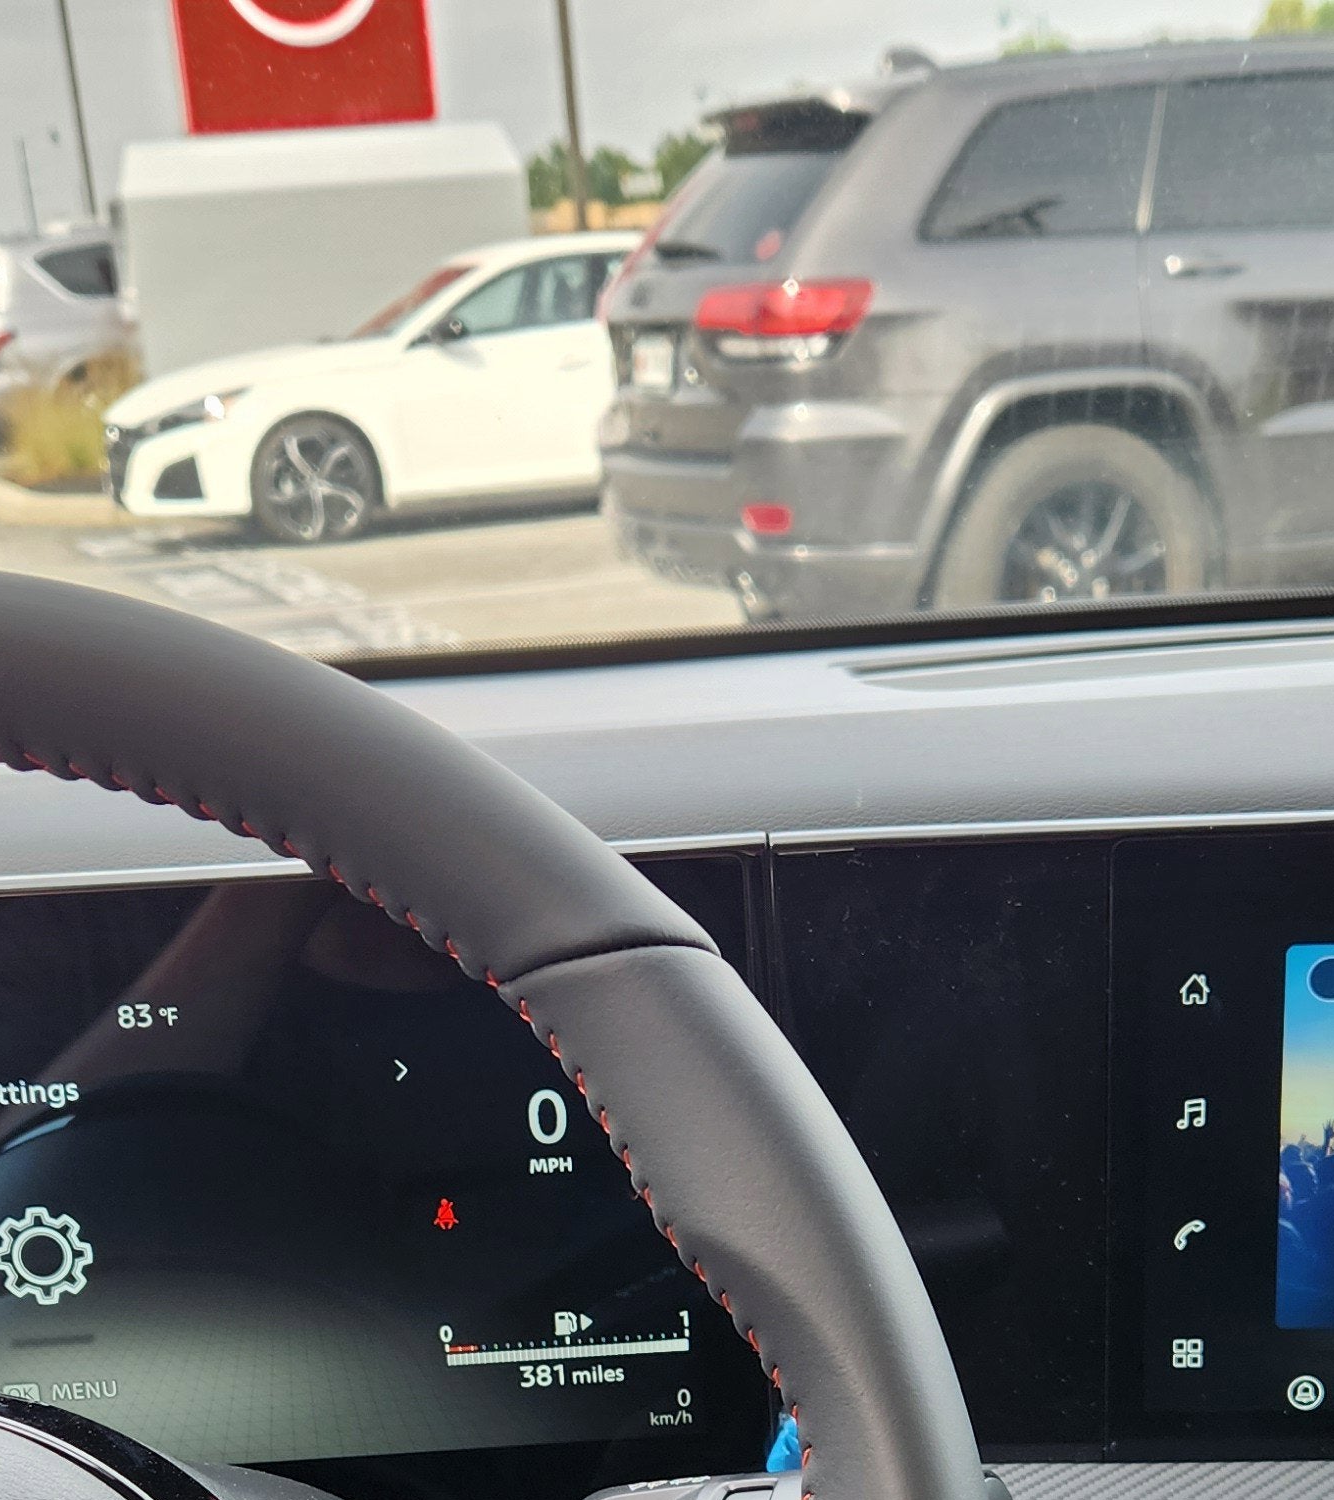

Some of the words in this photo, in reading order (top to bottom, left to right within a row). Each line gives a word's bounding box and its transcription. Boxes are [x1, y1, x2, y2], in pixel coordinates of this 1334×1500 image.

[117, 1003, 154, 1030] 83
[158, 1006, 179, 1027] °F
[528, 1088, 568, 1145] 0
[529, 1156, 573, 1175] MPH
[678, 1309, 690, 1328] 1
[439, 1324, 454, 1344] 0
[519, 1363, 566, 1388] 381
[572, 1364, 625, 1386] miles
[51, 1379, 117, 1401] MENU
[677, 1388, 692, 1407] 0
[649, 1409, 693, 1427] km/h
